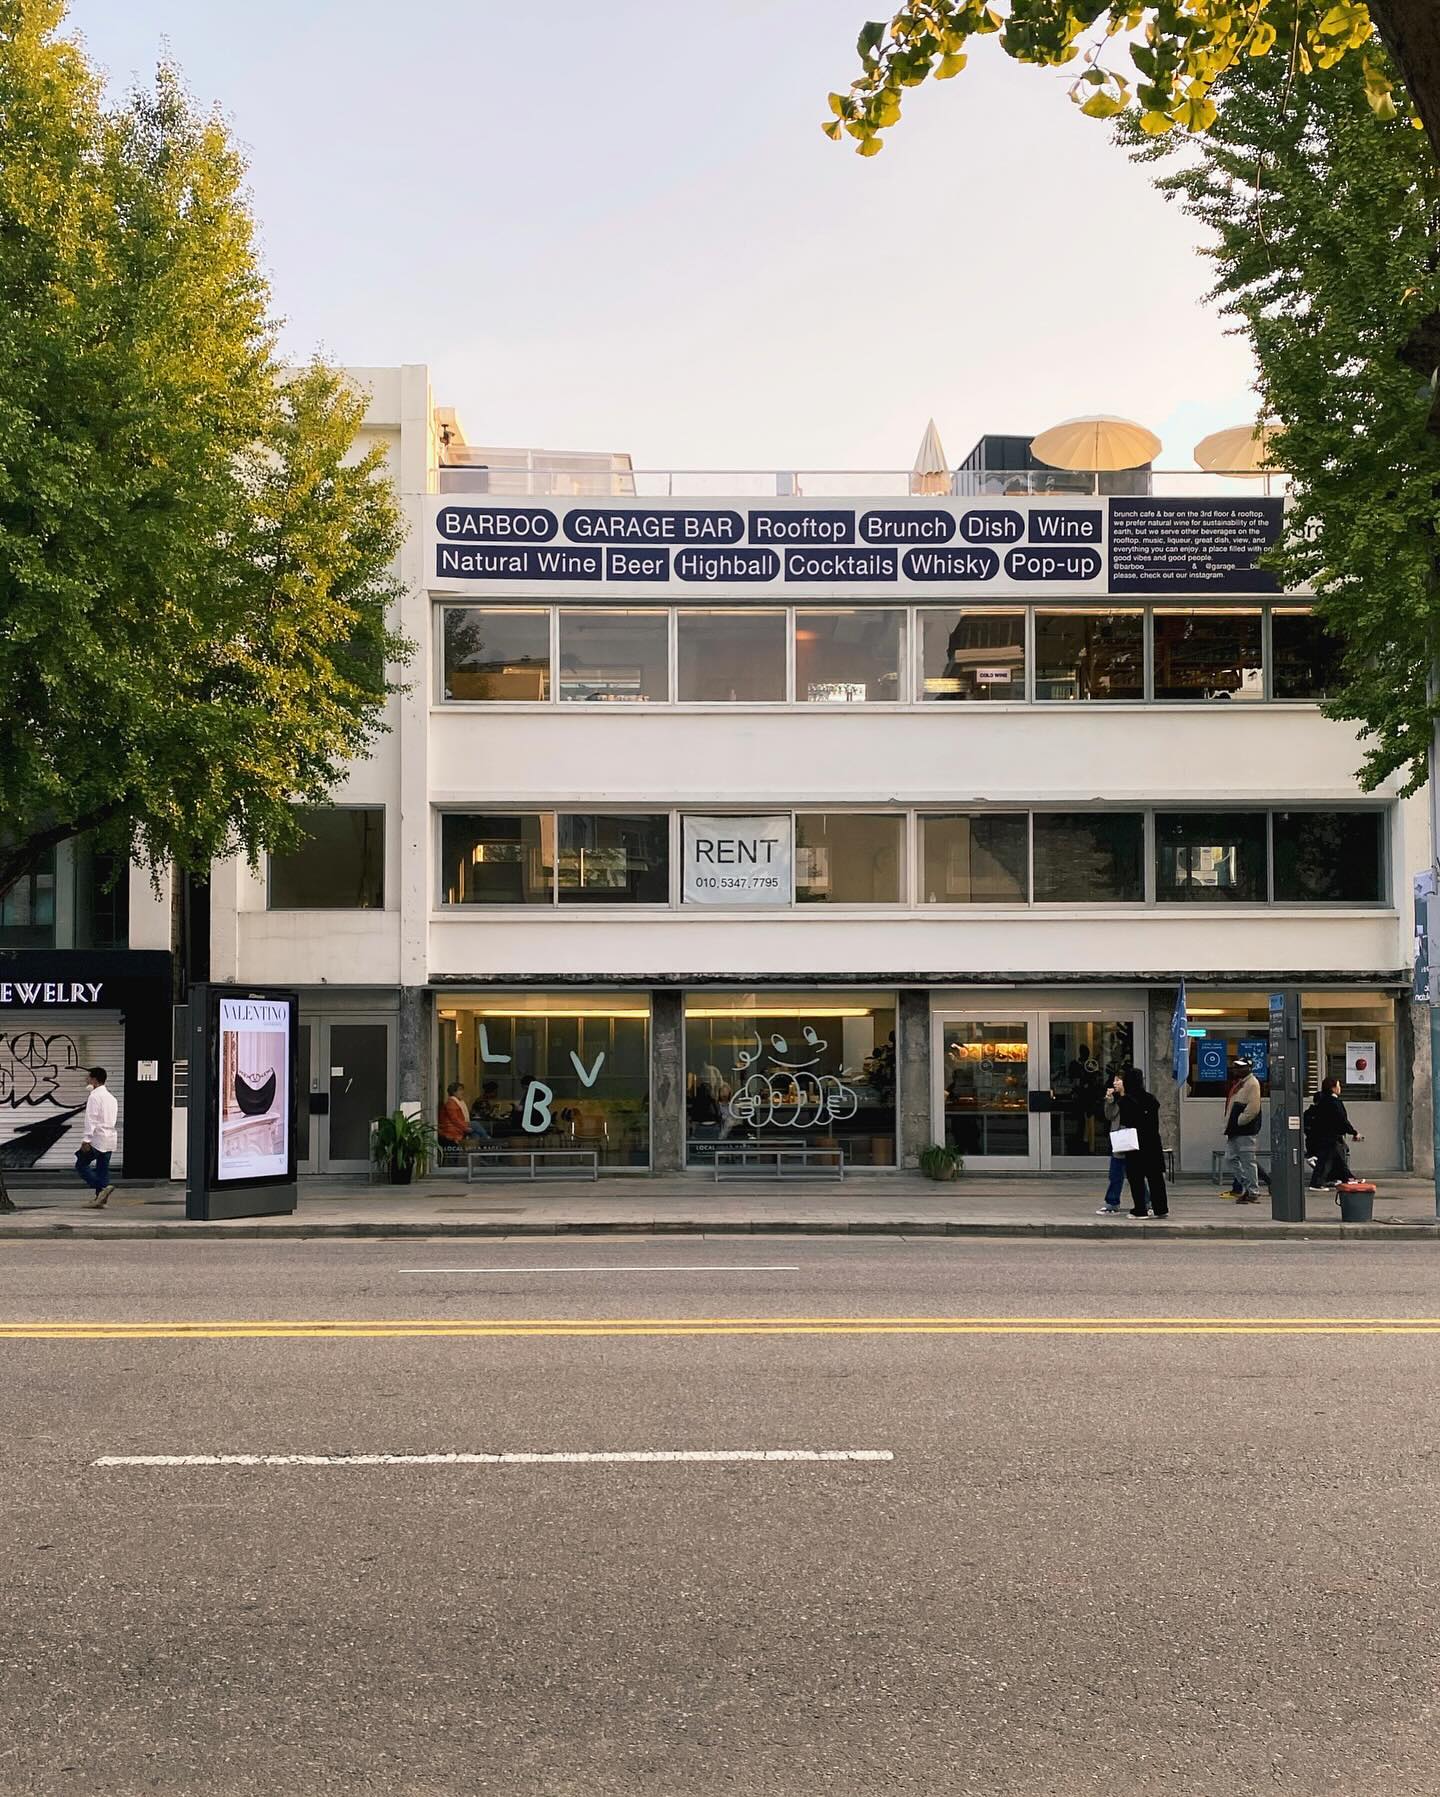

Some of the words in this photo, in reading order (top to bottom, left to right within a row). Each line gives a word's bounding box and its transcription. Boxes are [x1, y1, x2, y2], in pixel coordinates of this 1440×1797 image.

[445, 514, 550, 537] BARBOO
[574, 516, 675, 538] GARAGE
[683, 517, 734, 538] BAR
[756, 518, 847, 543] Rooftop
[867, 517, 947, 537] Brunch
[968, 516, 1017, 537] Dish
[1037, 516, 1095, 536] Wine
[1201, 528, 1236, 536] beverages
[1114, 546, 1149, 554] everything
[1209, 546, 1228, 554] place
[442, 551, 528, 573] Natural
[536, 552, 597, 572] Wine
[611, 555, 664, 575] Beer
[681, 556, 774, 580] Highball
[789, 555, 894, 576] Cocktails
[911, 553, 991, 579] Whisky
[1011, 553, 1096, 578] Pop-up
[696, 840, 778, 863] RENT
[696, 878, 778, 888] 010.5347.7795
[223, 1004, 287, 1021] VALENTINO
[478, 1023, 512, 1063] L
[570, 1050, 605, 1087] V
[522, 1080, 553, 1133] B
